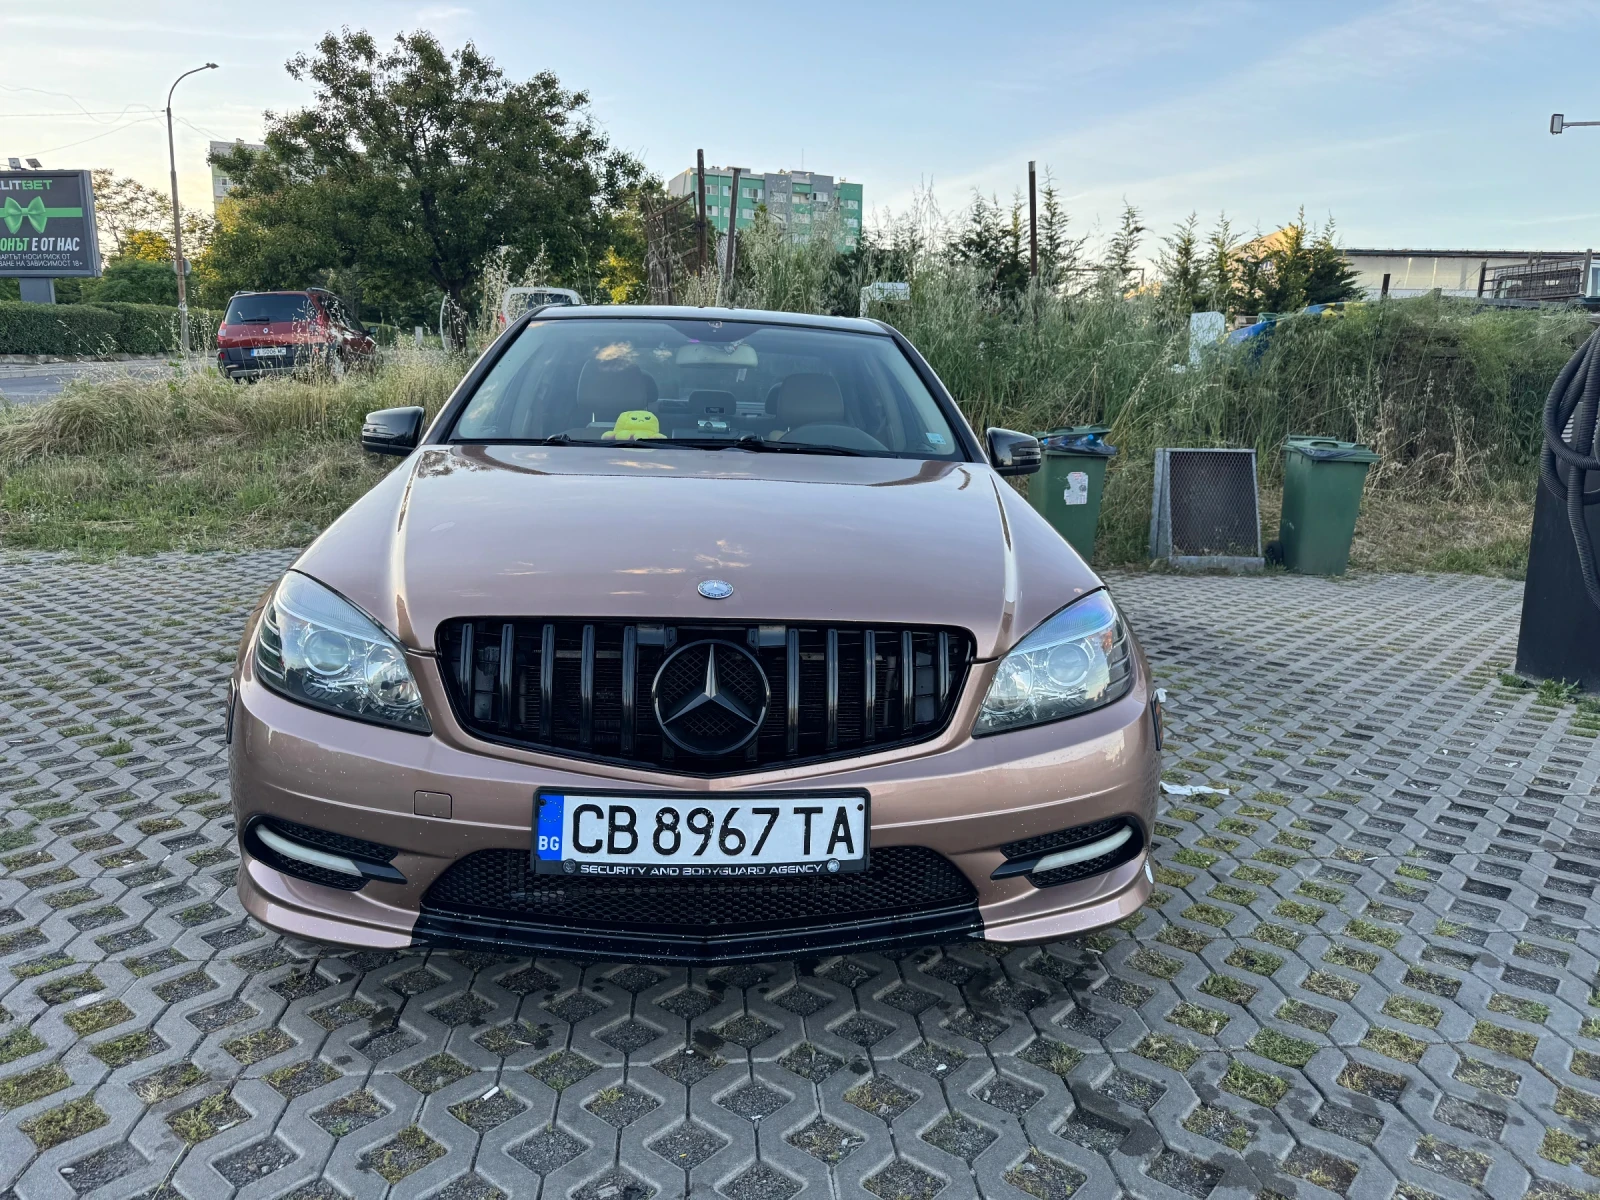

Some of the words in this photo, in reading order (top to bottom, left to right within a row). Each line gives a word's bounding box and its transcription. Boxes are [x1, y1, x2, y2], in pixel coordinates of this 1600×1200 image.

[0, 180, 52, 190] LITBET
[0, 237, 29, 252] ОНЪТ
[31, 237, 39, 252] Е
[40, 237, 55, 252] ОТ
[56, 237, 80, 252] НАС
[572, 803, 639, 855] CB
[652, 806, 780, 856] 8967
[793, 806, 855, 855] TA
[538, 835, 560, 851] BG
[580, 864, 647, 875] SECURITY
[650, 867, 680, 876] AND
[682, 866, 766, 876] BODYGUARD
[769, 863, 823, 875] AGENCY
